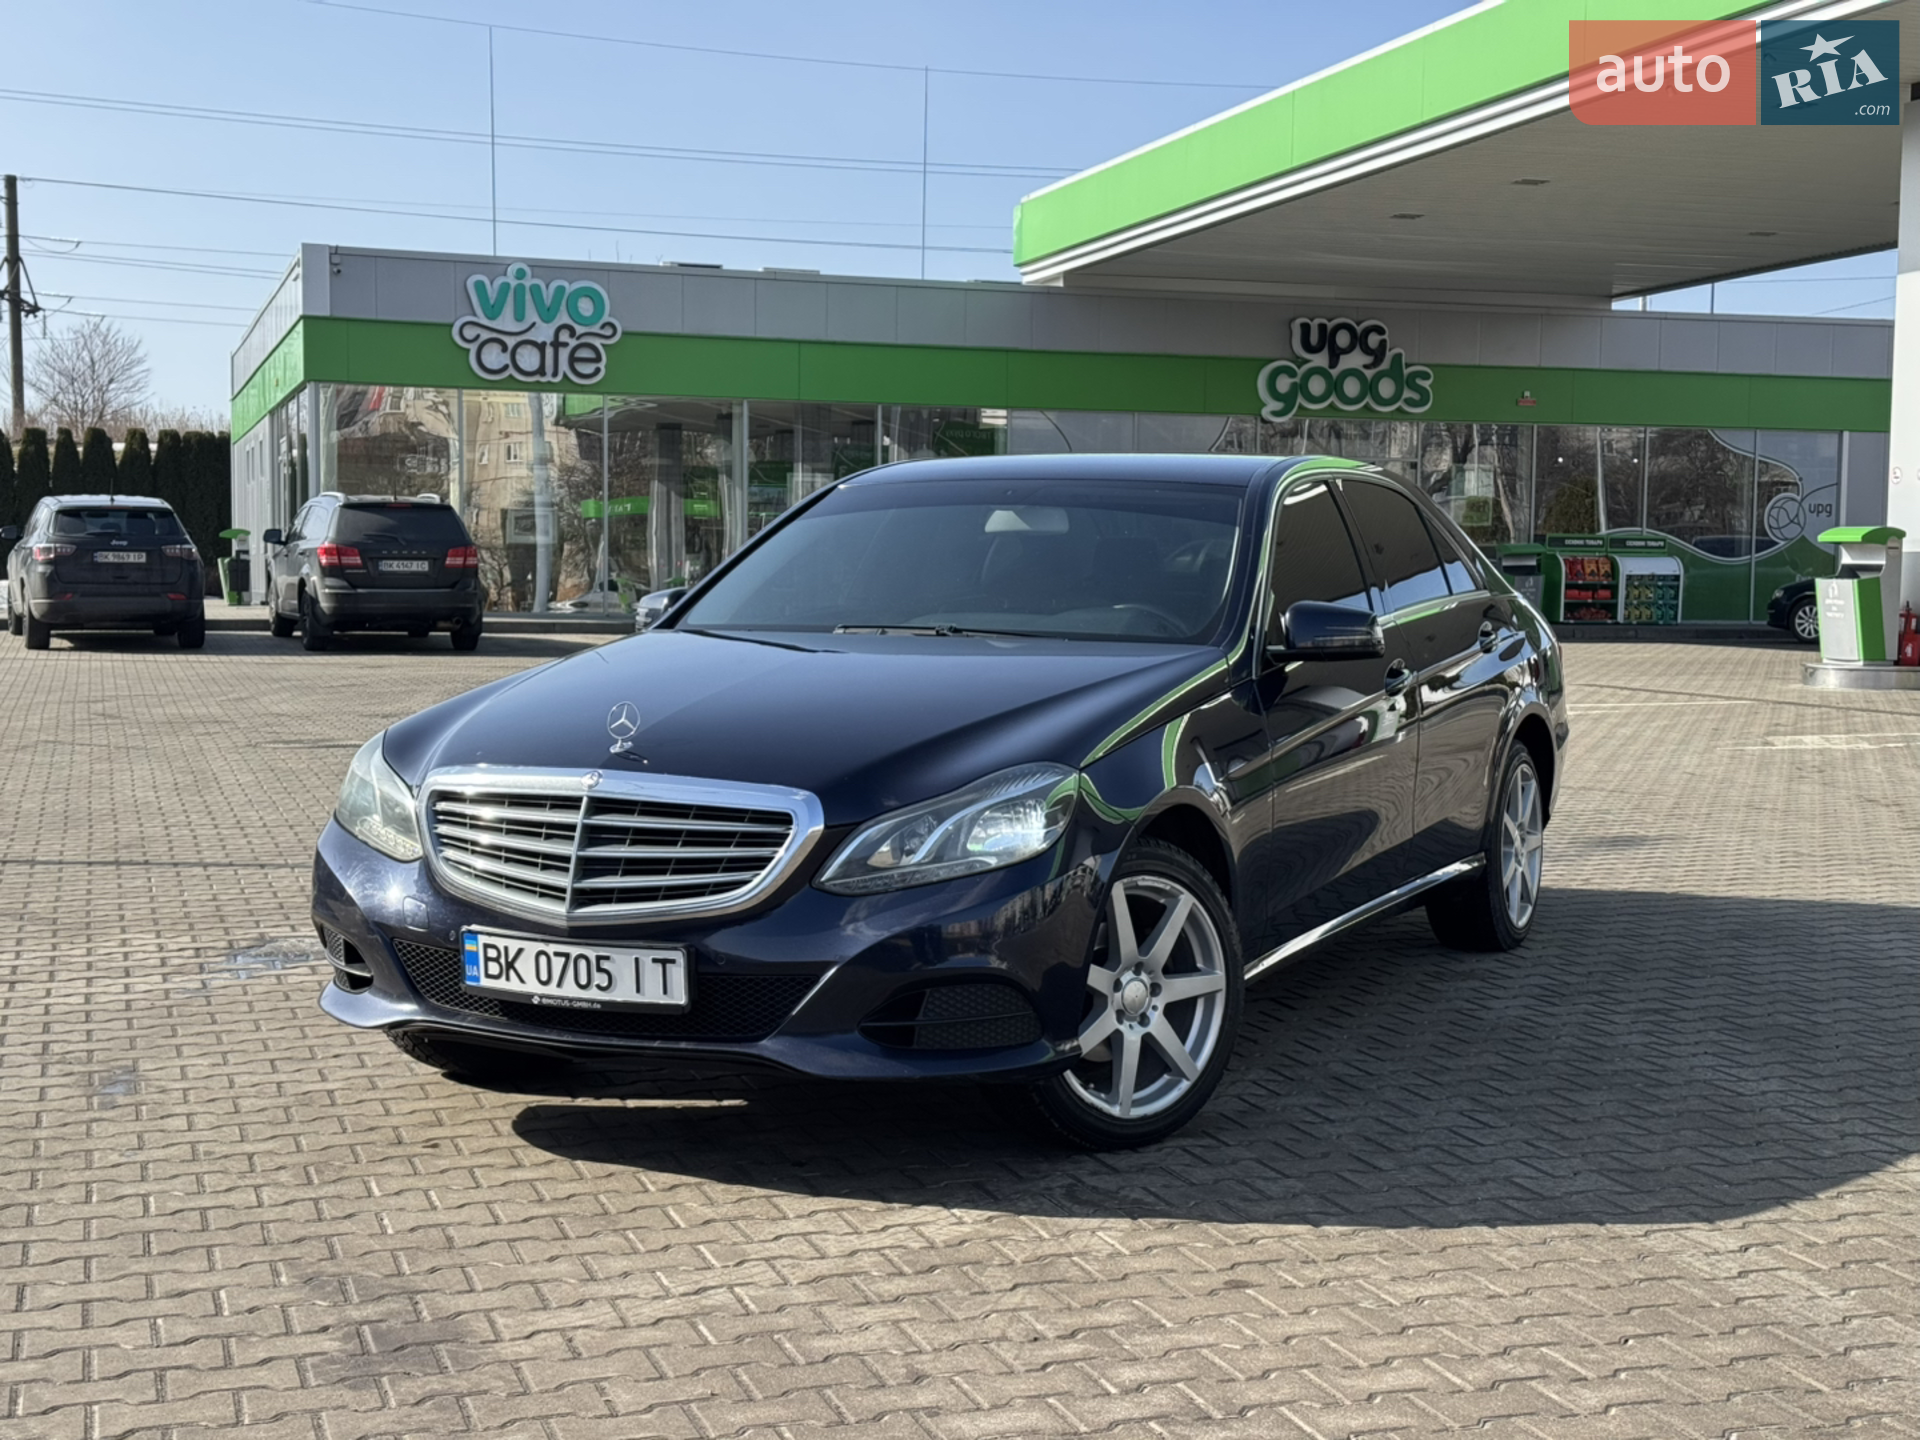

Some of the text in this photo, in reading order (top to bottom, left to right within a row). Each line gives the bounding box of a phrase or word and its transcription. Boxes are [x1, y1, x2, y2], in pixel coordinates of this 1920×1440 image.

[473, 267, 606, 326] vivo
[1300, 322, 1387, 369] upg
[1266, 352, 1432, 417] goods
[1808, 503, 1833, 517] upg
[416, 562, 426, 570] IC
[466, 964, 479, 977] UA
[482, 943, 677, 995] BK 0705 IT
